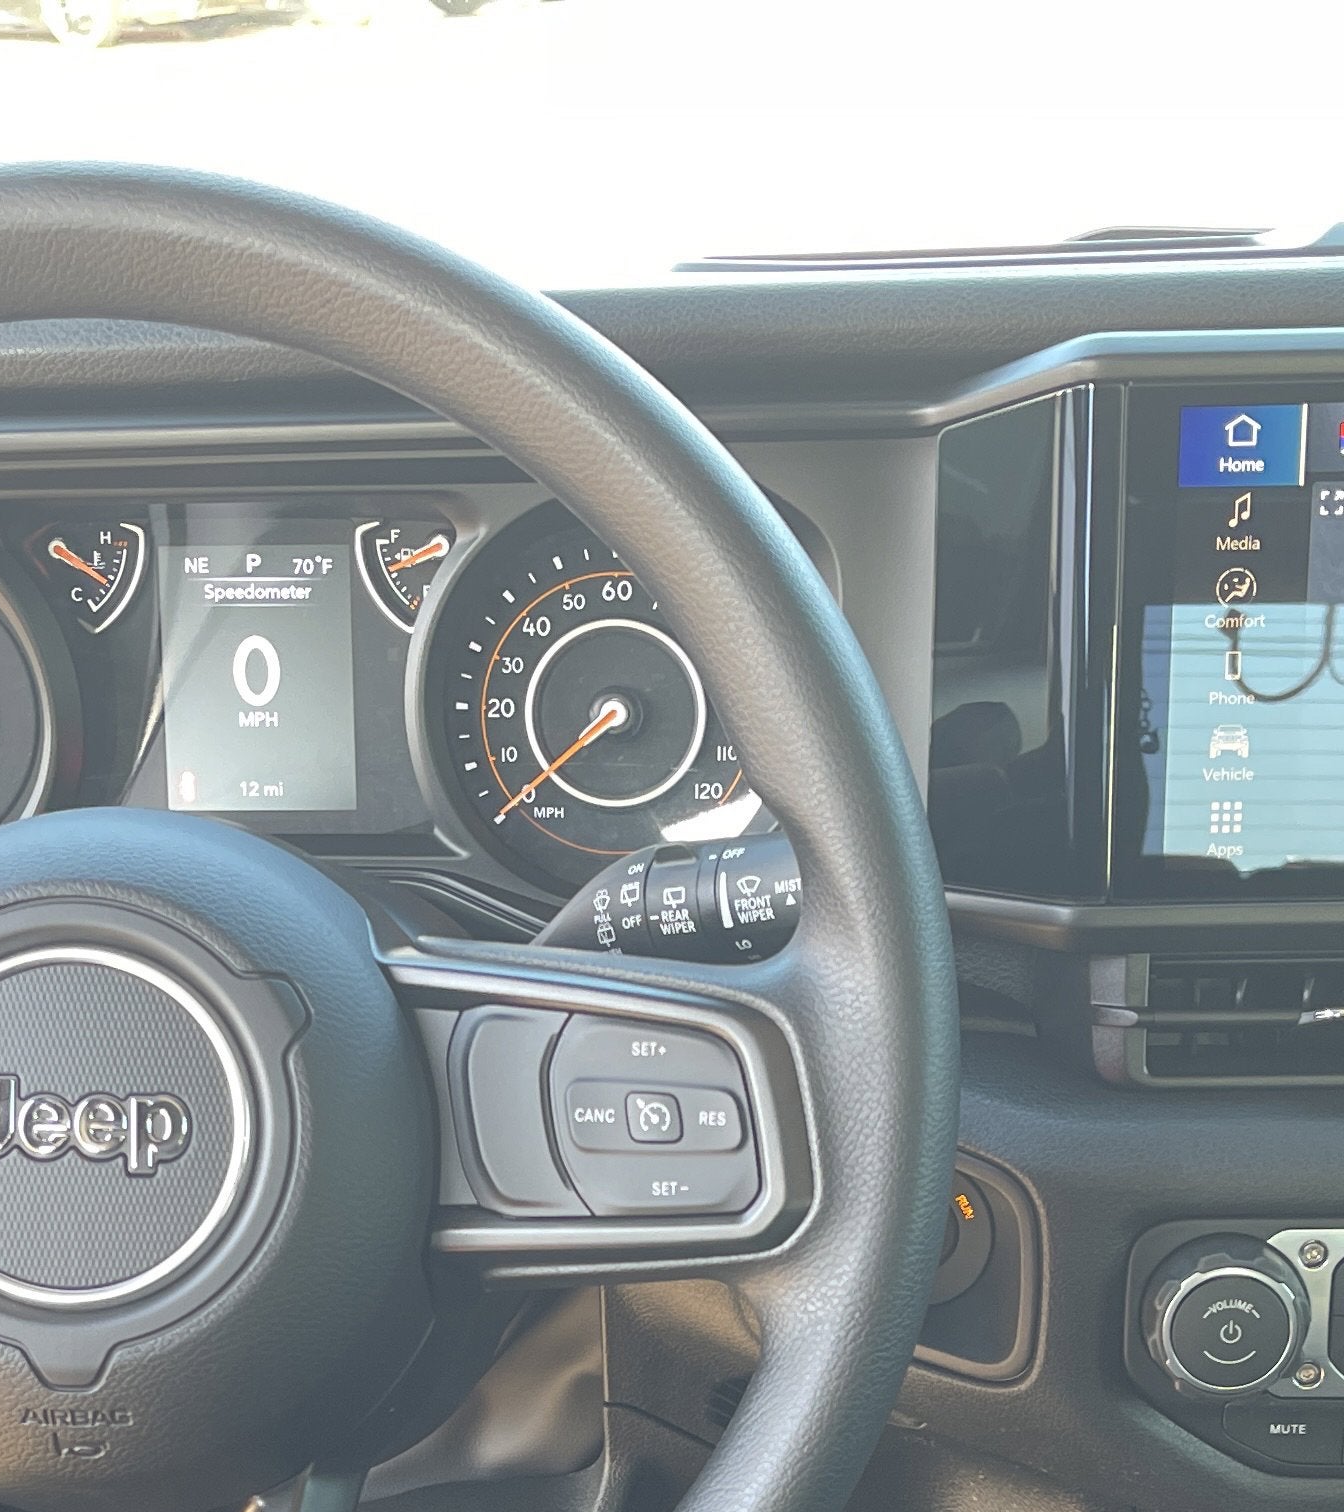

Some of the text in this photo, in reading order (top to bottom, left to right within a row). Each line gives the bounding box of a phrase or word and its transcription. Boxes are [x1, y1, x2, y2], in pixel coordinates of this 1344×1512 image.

[1219, 456, 1265, 473] Home
[100, 531, 112, 544] H
[390, 529, 401, 543] F
[1215, 535, 1261, 551] Media
[184, 554, 333, 575] NE P 70°F
[71, 587, 83, 602] C
[204, 584, 312, 601] Speedometer
[601, 581, 633, 601] 60
[562, 594, 586, 610] 50
[522, 616, 551, 637] 40
[1204, 614, 1266, 629] Comfort
[232, 634, 281, 707] 0
[501, 657, 524, 674] 30
[1208, 691, 1256, 705] Phone
[487, 698, 515, 718] 20
[238, 711, 279, 728] MPH
[500, 747, 518, 762] 10
[1202, 766, 1254, 781] Vehicle
[239, 781, 284, 797] 12 mi
[694, 783, 724, 799] 120
[533, 807, 565, 819] MPH
[722, 847, 746, 860] OFF
[1206, 843, 1244, 859] Apps
[627, 863, 645, 876] ON
[774, 877, 802, 895] MIST
[734, 895, 772, 911] FRONT
[621, 914, 643, 930] OFF
[660, 908, 690, 922] REAR
[737, 908, 775, 924] WIPER
[659, 921, 696, 935] WIPER
[574, 1107, 616, 1125] CANC
[698, 1111, 727, 1127] RES
[1208, 1299, 1254, 1313] VOLUME
[19, 1406, 135, 1428] AIRBAG
[1269, 1423, 1307, 1435] MUTE
